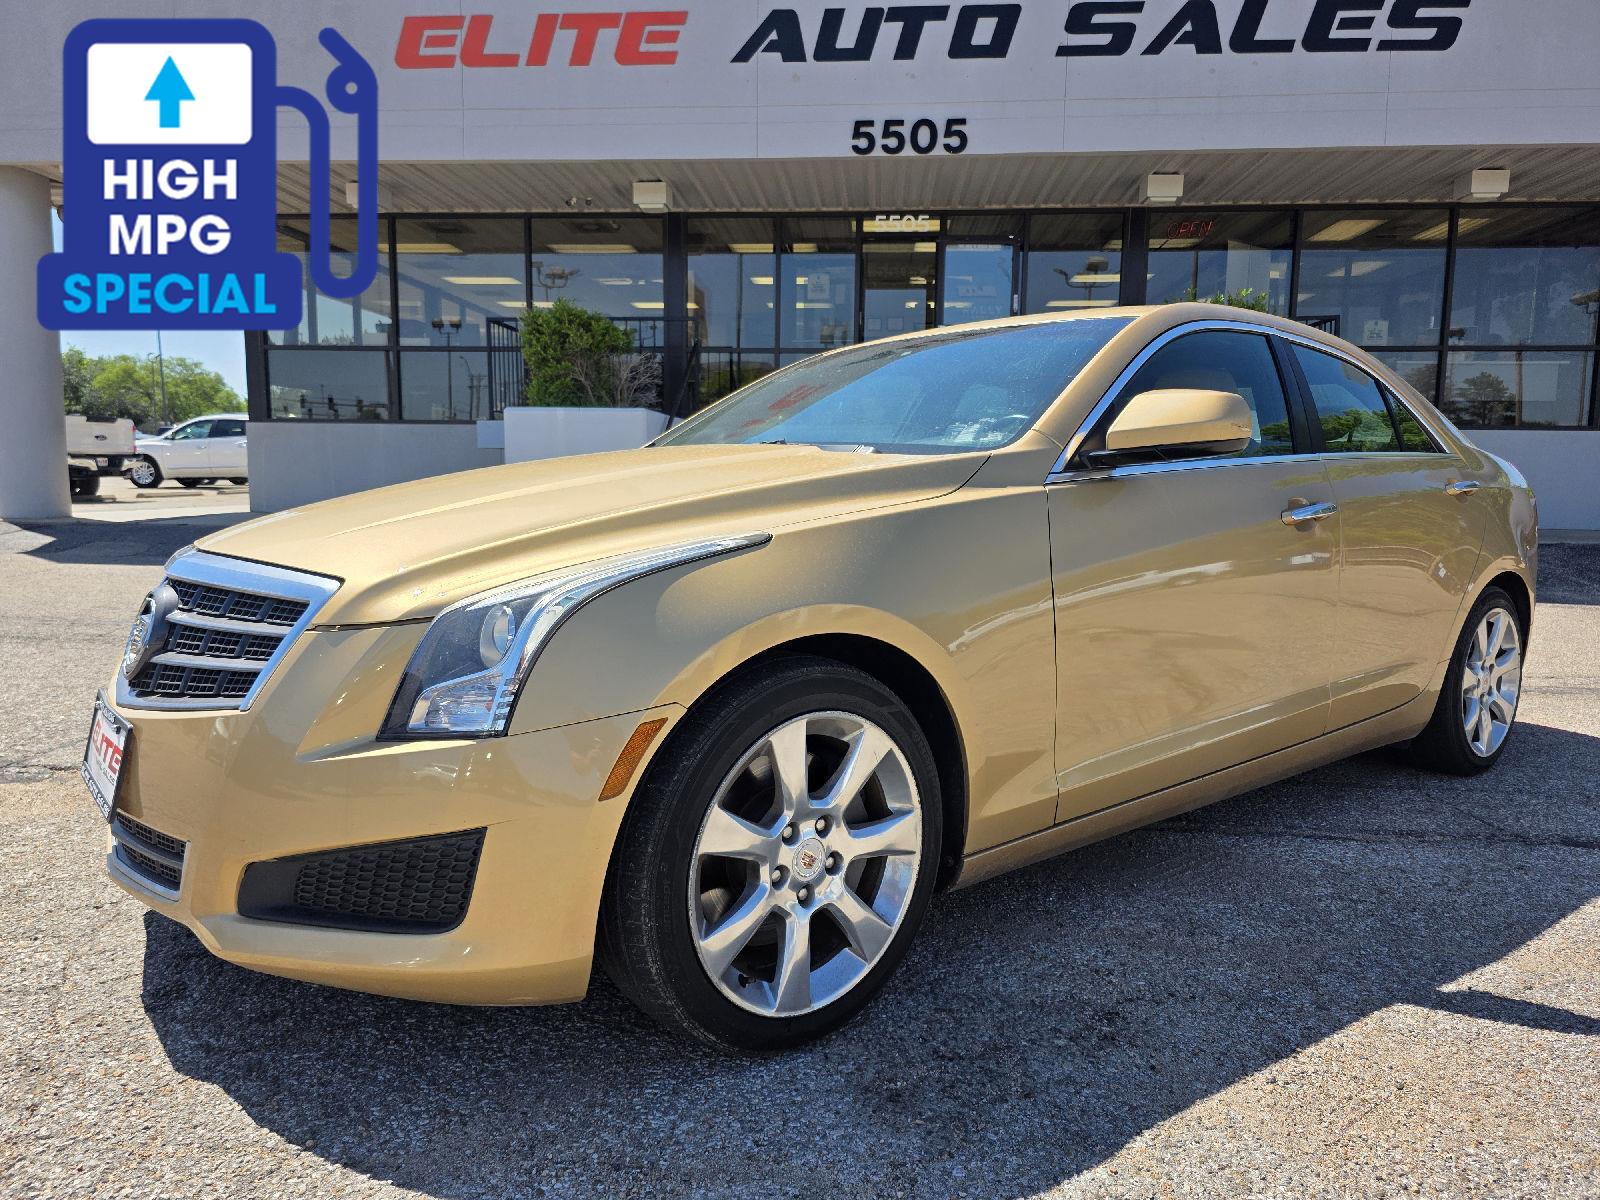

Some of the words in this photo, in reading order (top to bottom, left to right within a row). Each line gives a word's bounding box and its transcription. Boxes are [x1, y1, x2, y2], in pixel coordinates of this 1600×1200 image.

[395, 11, 688, 69] ELITE
[730, 3, 1022, 64] AUTO
[1056, 0, 1472, 58] SALES
[852, 117, 968, 156] 5505
[875, 215, 931, 232] 5505
[1167, 221, 1214, 239] OPEN
